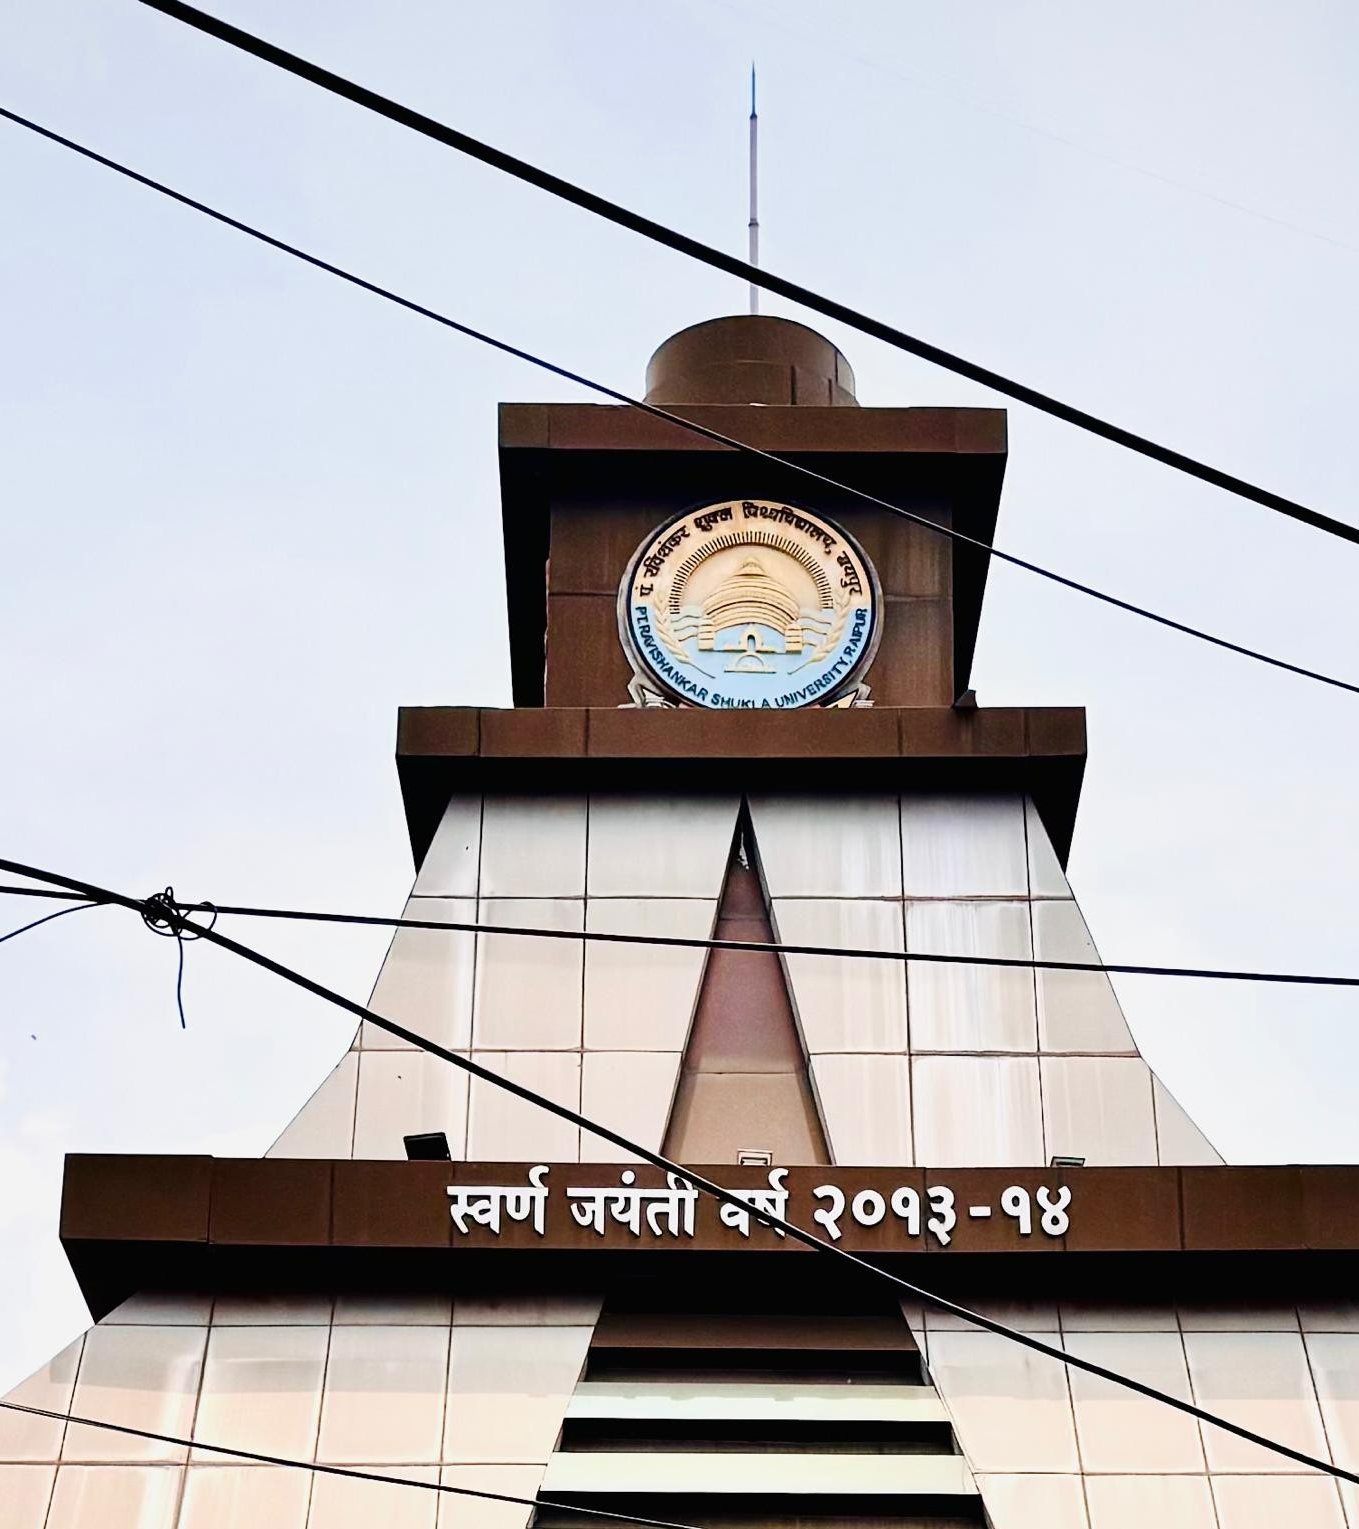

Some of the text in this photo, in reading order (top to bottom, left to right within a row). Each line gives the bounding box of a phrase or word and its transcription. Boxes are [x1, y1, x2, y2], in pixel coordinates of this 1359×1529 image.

[836, 550, 863, 597] रायपुर
[844, 608, 868, 657] RAIPUR
[446, 1164, 549, 1236] स्वर्ण
[567, 1169, 699, 1238] जयंती
[718, 1166, 789, 1238] वर्ष
